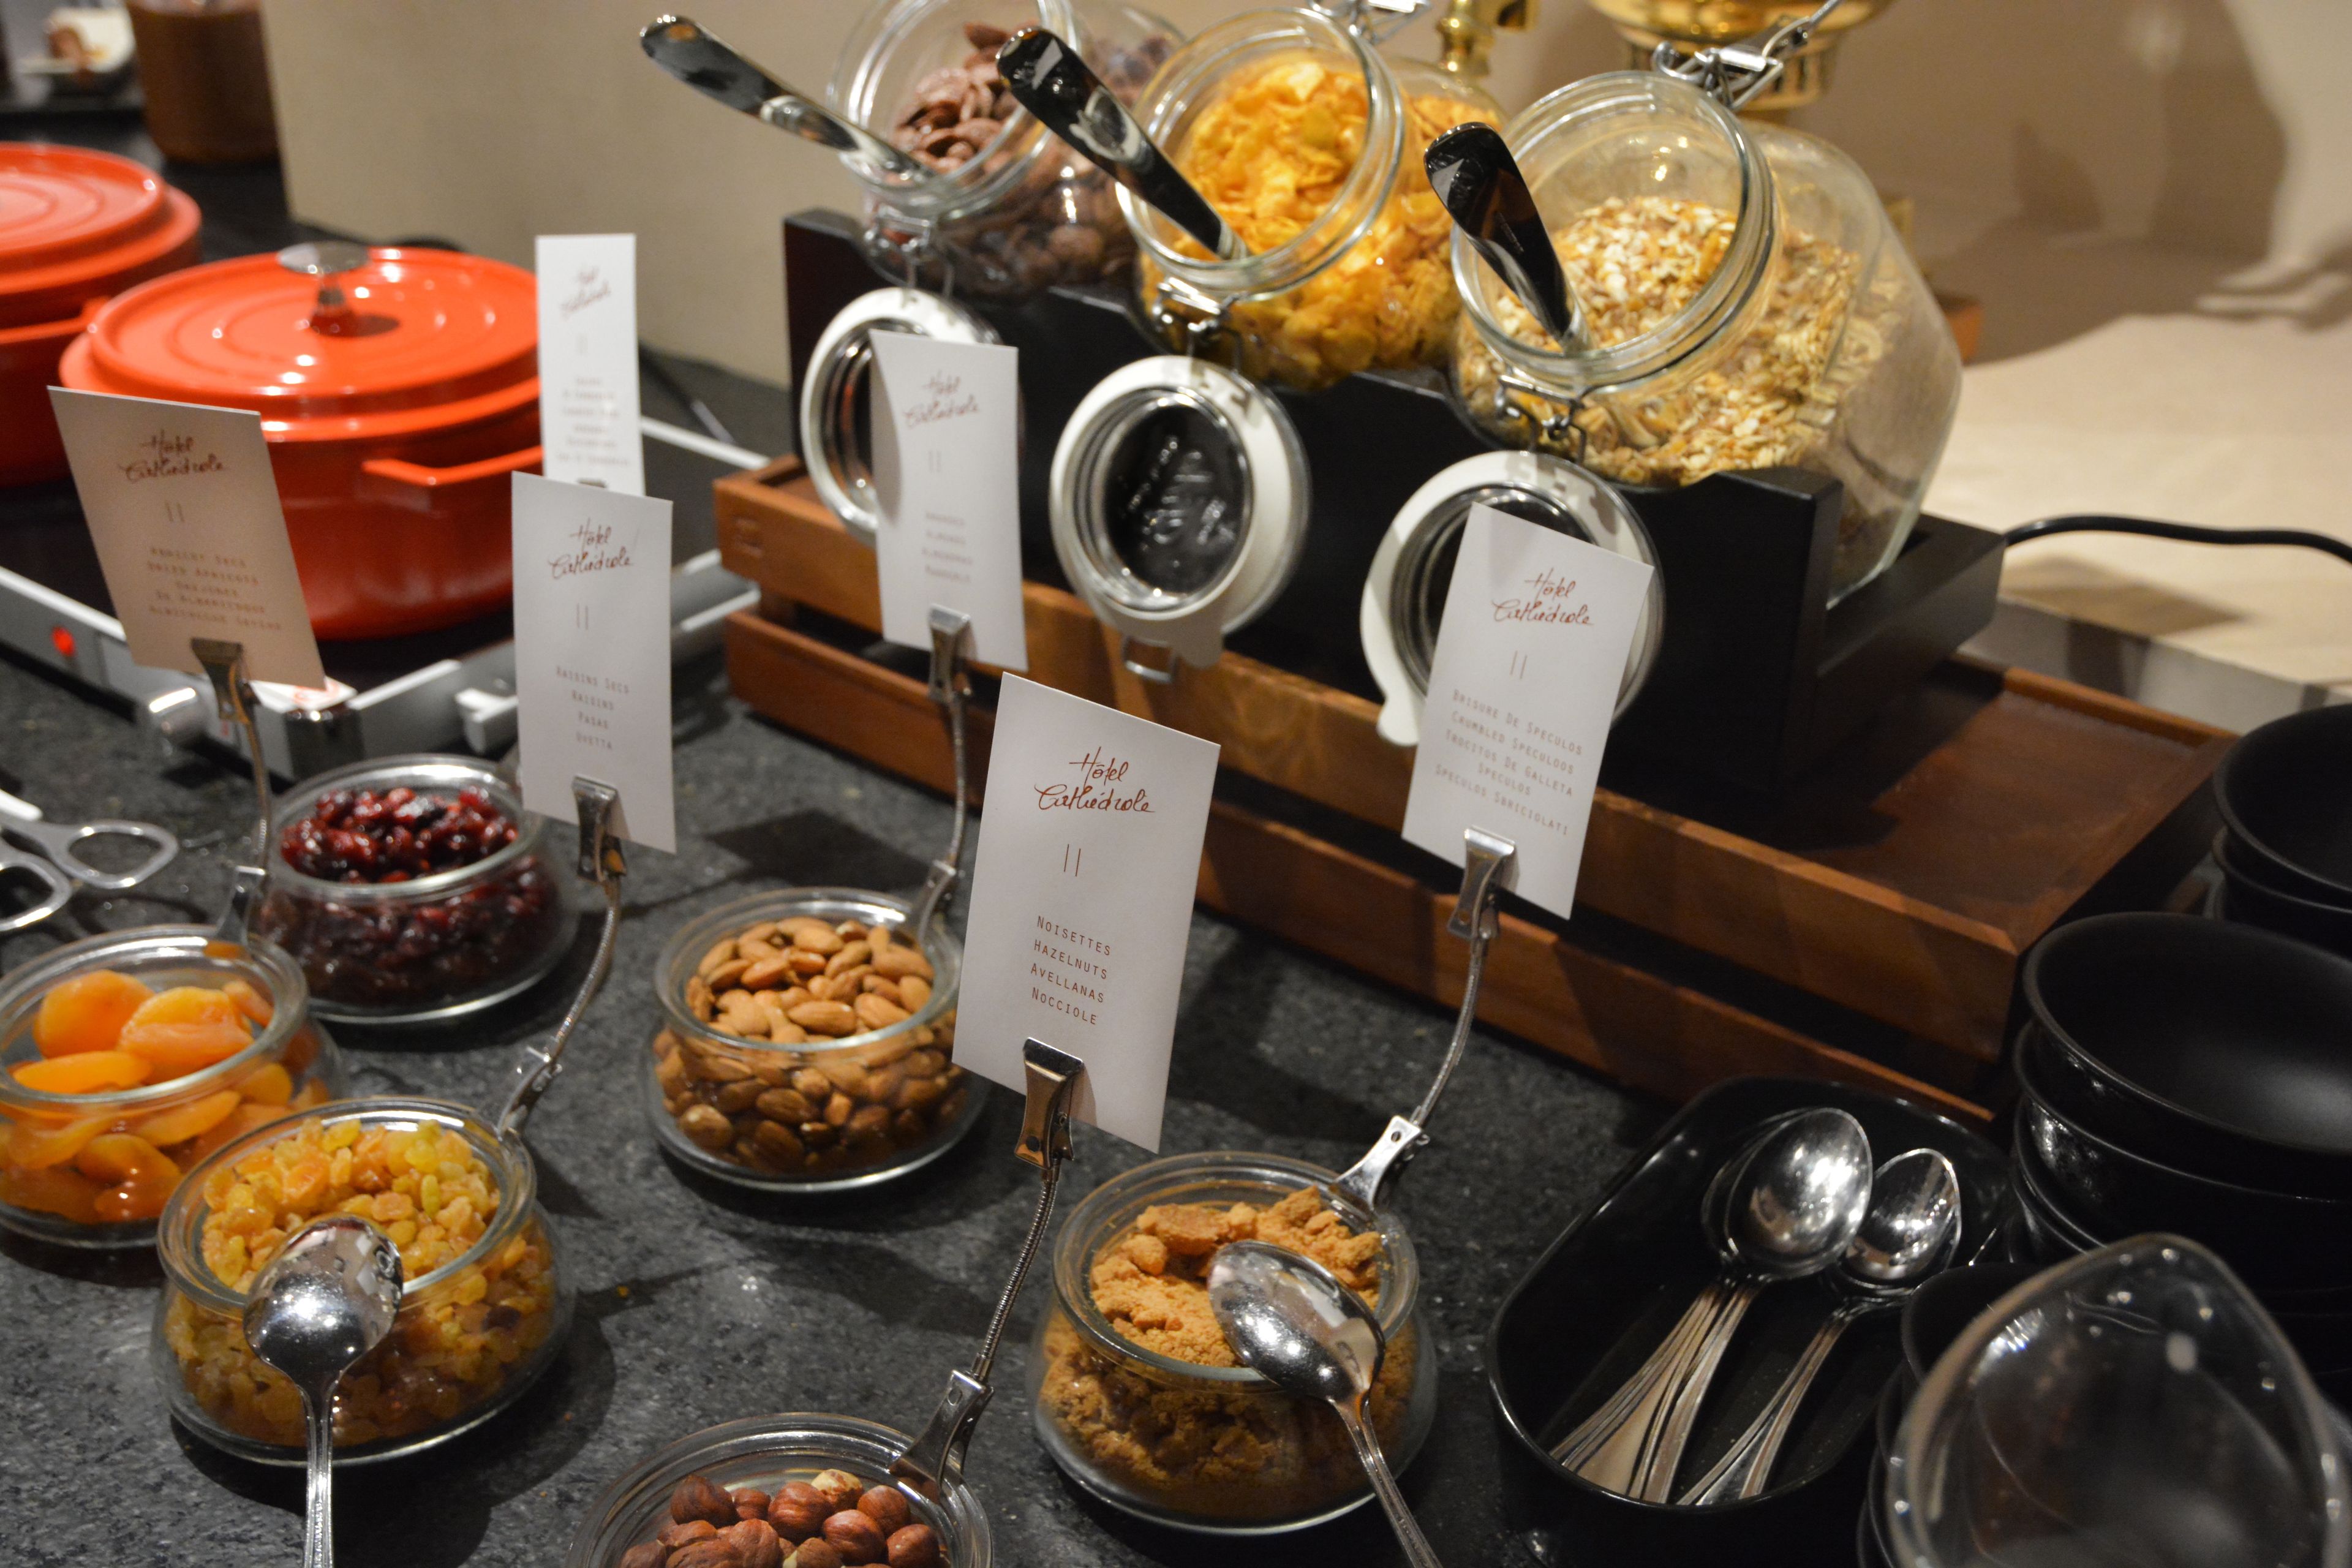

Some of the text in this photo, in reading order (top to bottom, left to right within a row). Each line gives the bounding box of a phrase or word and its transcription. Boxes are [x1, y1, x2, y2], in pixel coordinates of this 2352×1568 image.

[1528, 722, 1583, 755] SPECULOS
[1525, 766, 1572, 796] GALLETA
[1037, 915, 1110, 956] NOISETTES
[1034, 939, 1107, 980] HAZELNUTS
[1031, 962, 1104, 1003] AVELLANAS
[1031, 987, 1098, 1025] NOCCIOLE
